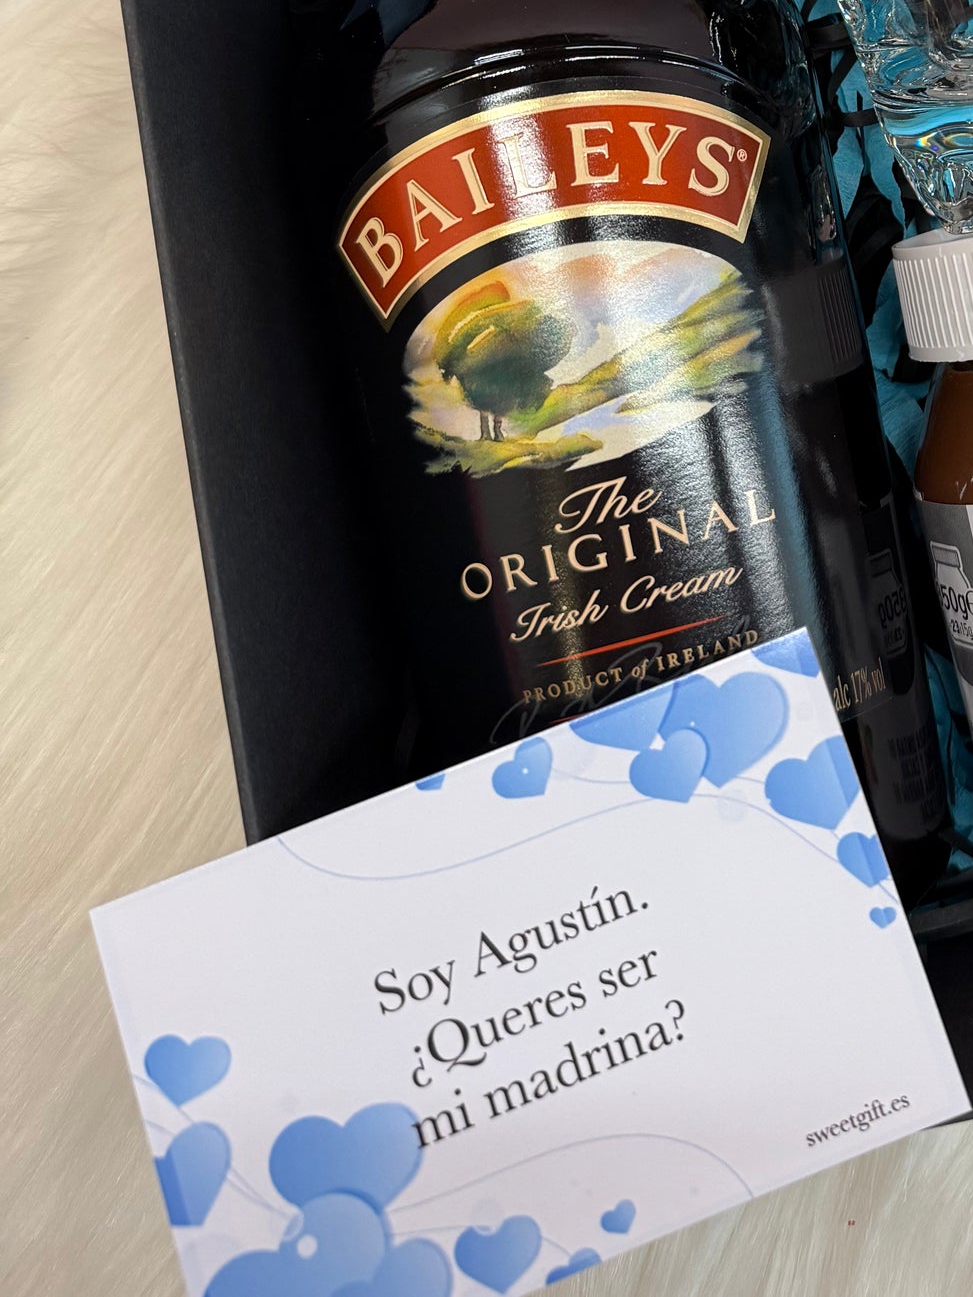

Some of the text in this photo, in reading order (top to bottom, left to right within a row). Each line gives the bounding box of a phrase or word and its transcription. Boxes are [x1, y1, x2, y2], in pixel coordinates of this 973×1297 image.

[554, 475, 663, 534] The
[461, 488, 777, 600] ORIGINAL
[510, 566, 743, 643] Irish Cream
[523, 629, 759, 704] PRODUCT of IRELAND
[833, 656, 886, 711] alc 17% vol
[373, 886, 649, 1015] Soy Agustín.
[411, 949, 659, 1088] ¿Queres ser
[411, 999, 688, 1149] mi madrina?
[804, 1091, 911, 1148] sweetgift.es
